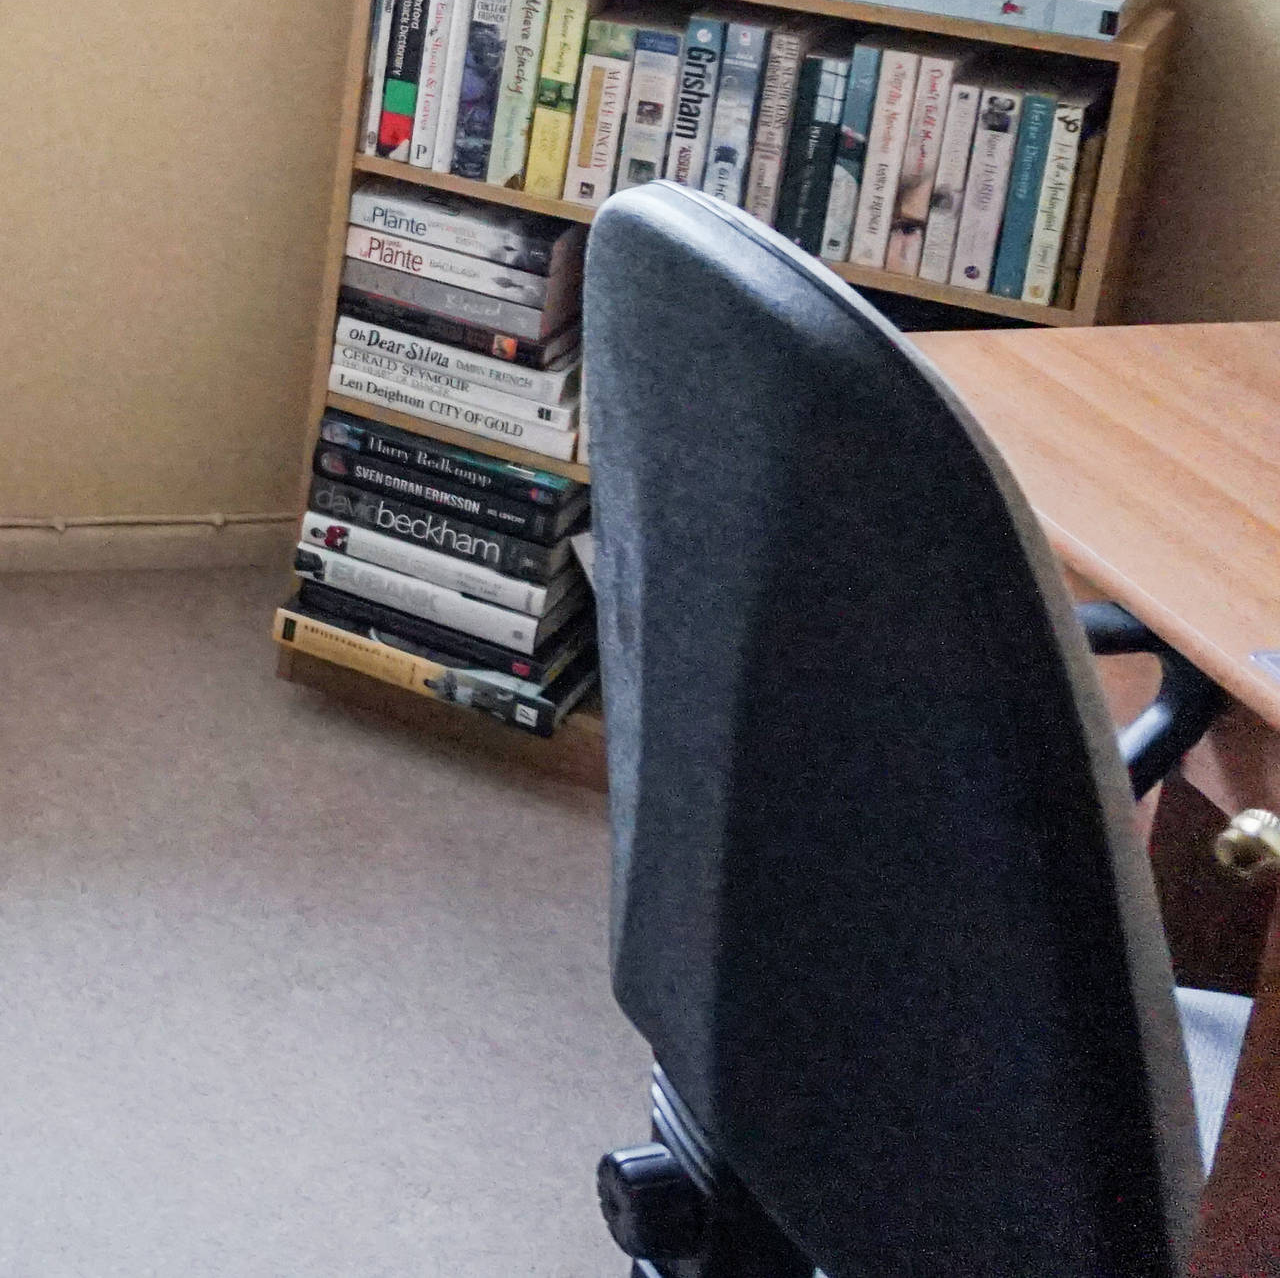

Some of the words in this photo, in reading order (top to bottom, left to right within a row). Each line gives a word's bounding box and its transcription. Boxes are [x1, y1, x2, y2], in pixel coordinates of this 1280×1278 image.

[393, 23, 409, 76] Dictionary
[508, 43, 534, 95] Binchy
[675, 46, 717, 140] Grisham
[593, 120, 613, 168] BINCHY
[372, 206, 427, 237] Plante
[868, 195, 886, 235] FRENCH
[368, 236, 424, 272] Plante
[342, 348, 398, 371] GERALD
[401, 365, 470, 392] SEYMOUR
[349, 328, 366, 341] Oh
[367, 330, 405, 355] Dear
[405, 342, 450, 368] Silvia
[489, 368, 533, 388] FRENCH
[340, 374, 363, 391] Len
[366, 381, 425, 409] Deighton
[429, 400, 462, 419] CITY
[464, 410, 483, 424] OF
[483, 415, 524, 437] GOLD
[368, 436, 410, 464] Harry
[416, 451, 492, 488] Redknapp
[355, 466, 384, 485] SVEN
[425, 486, 481, 515] ERIKSSON
[377, 500, 501, 564] beckham
